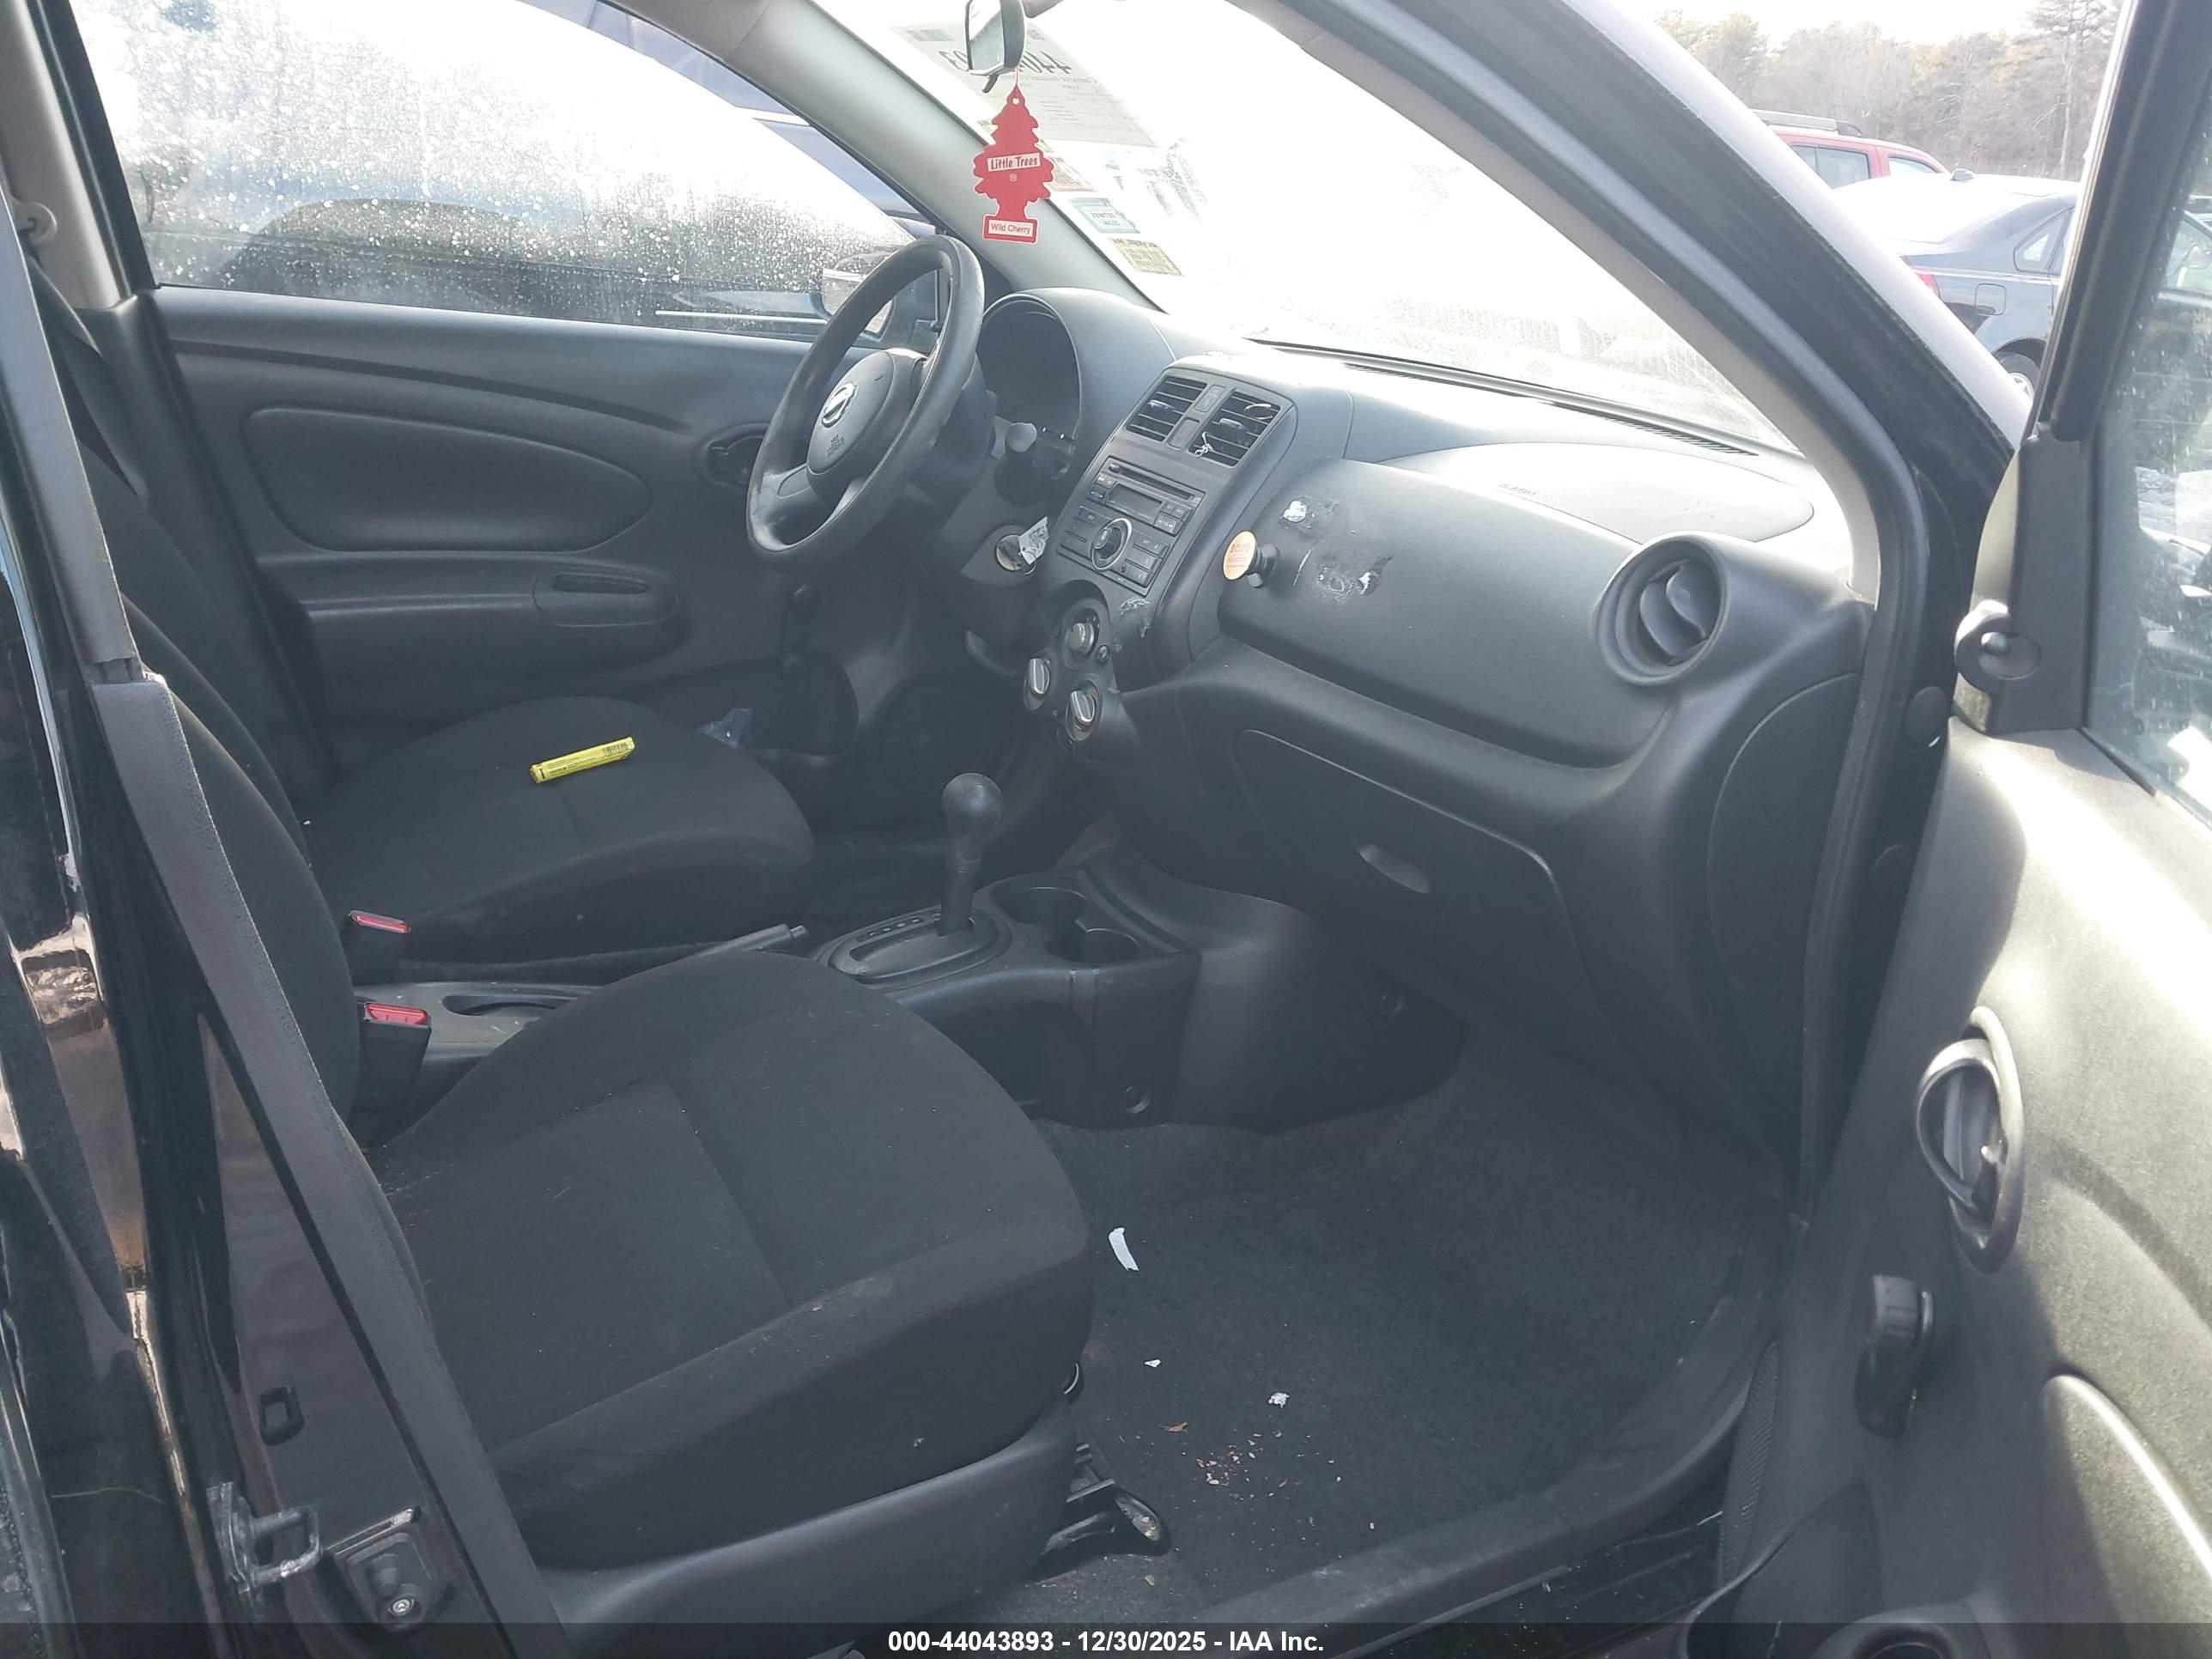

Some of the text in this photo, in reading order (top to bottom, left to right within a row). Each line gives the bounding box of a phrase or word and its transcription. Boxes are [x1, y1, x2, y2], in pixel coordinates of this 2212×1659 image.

[990, 156, 1037, 169] Little Trees
[990, 222, 1030, 234] Wild Cherry
